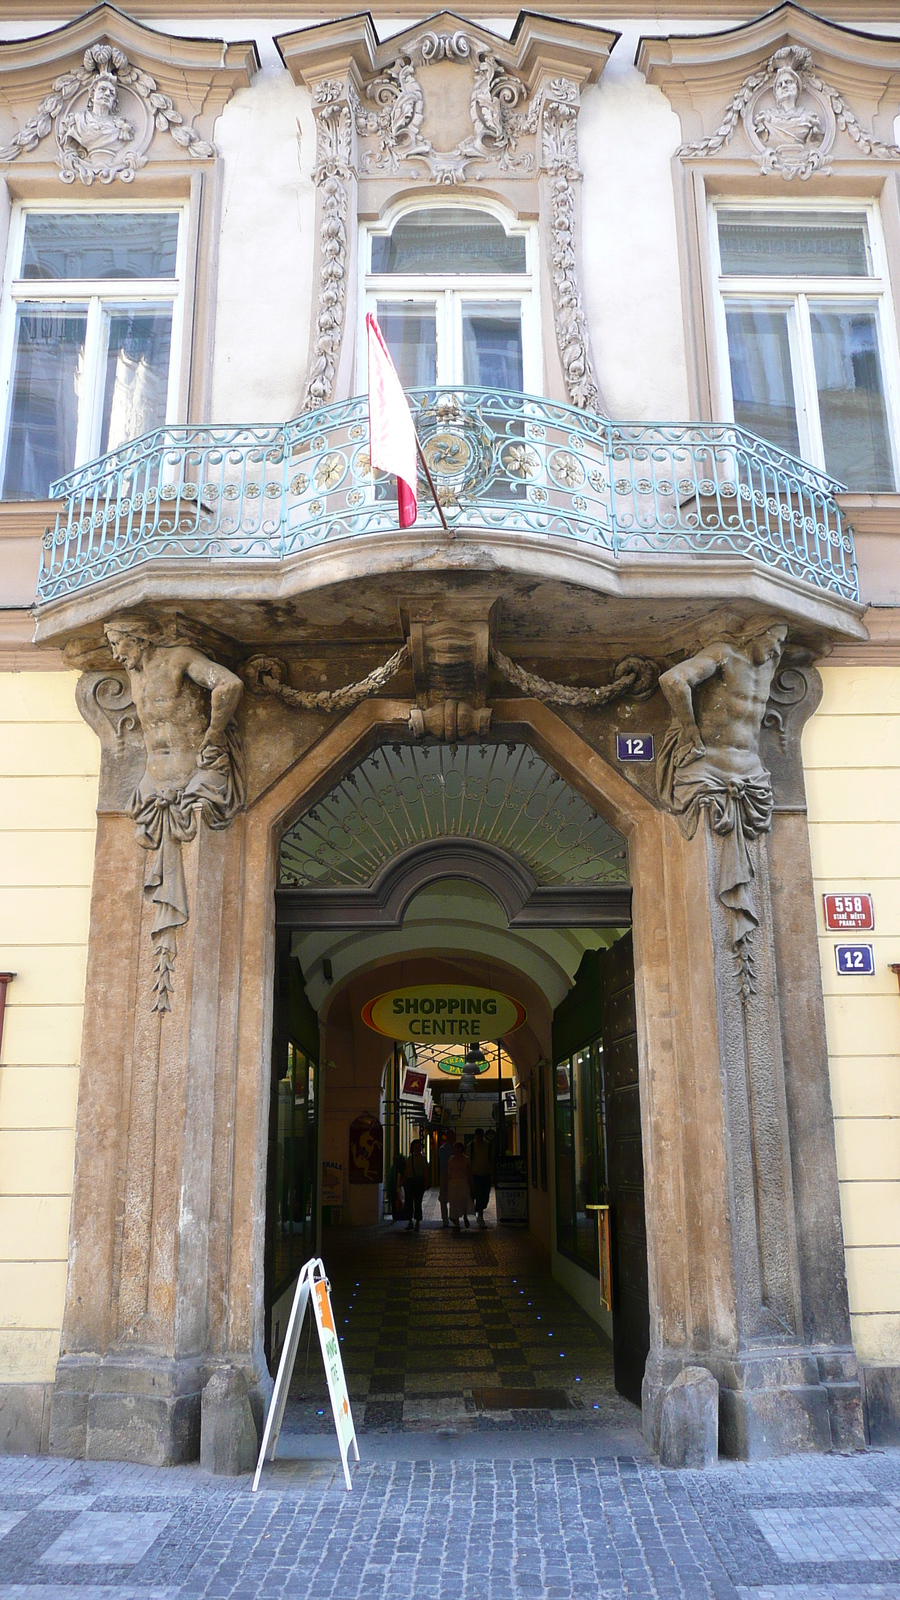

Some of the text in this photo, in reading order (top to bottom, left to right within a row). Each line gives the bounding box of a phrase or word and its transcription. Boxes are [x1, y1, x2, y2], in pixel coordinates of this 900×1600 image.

[625, 739, 644, 755] 12
[834, 897, 862, 912] 558
[833, 912, 866, 920] STARÉ MĚSTO
[844, 951, 864, 968] 12
[392, 998, 497, 1015] SHOPPING
[408, 1019, 481, 1035] CENTRE
